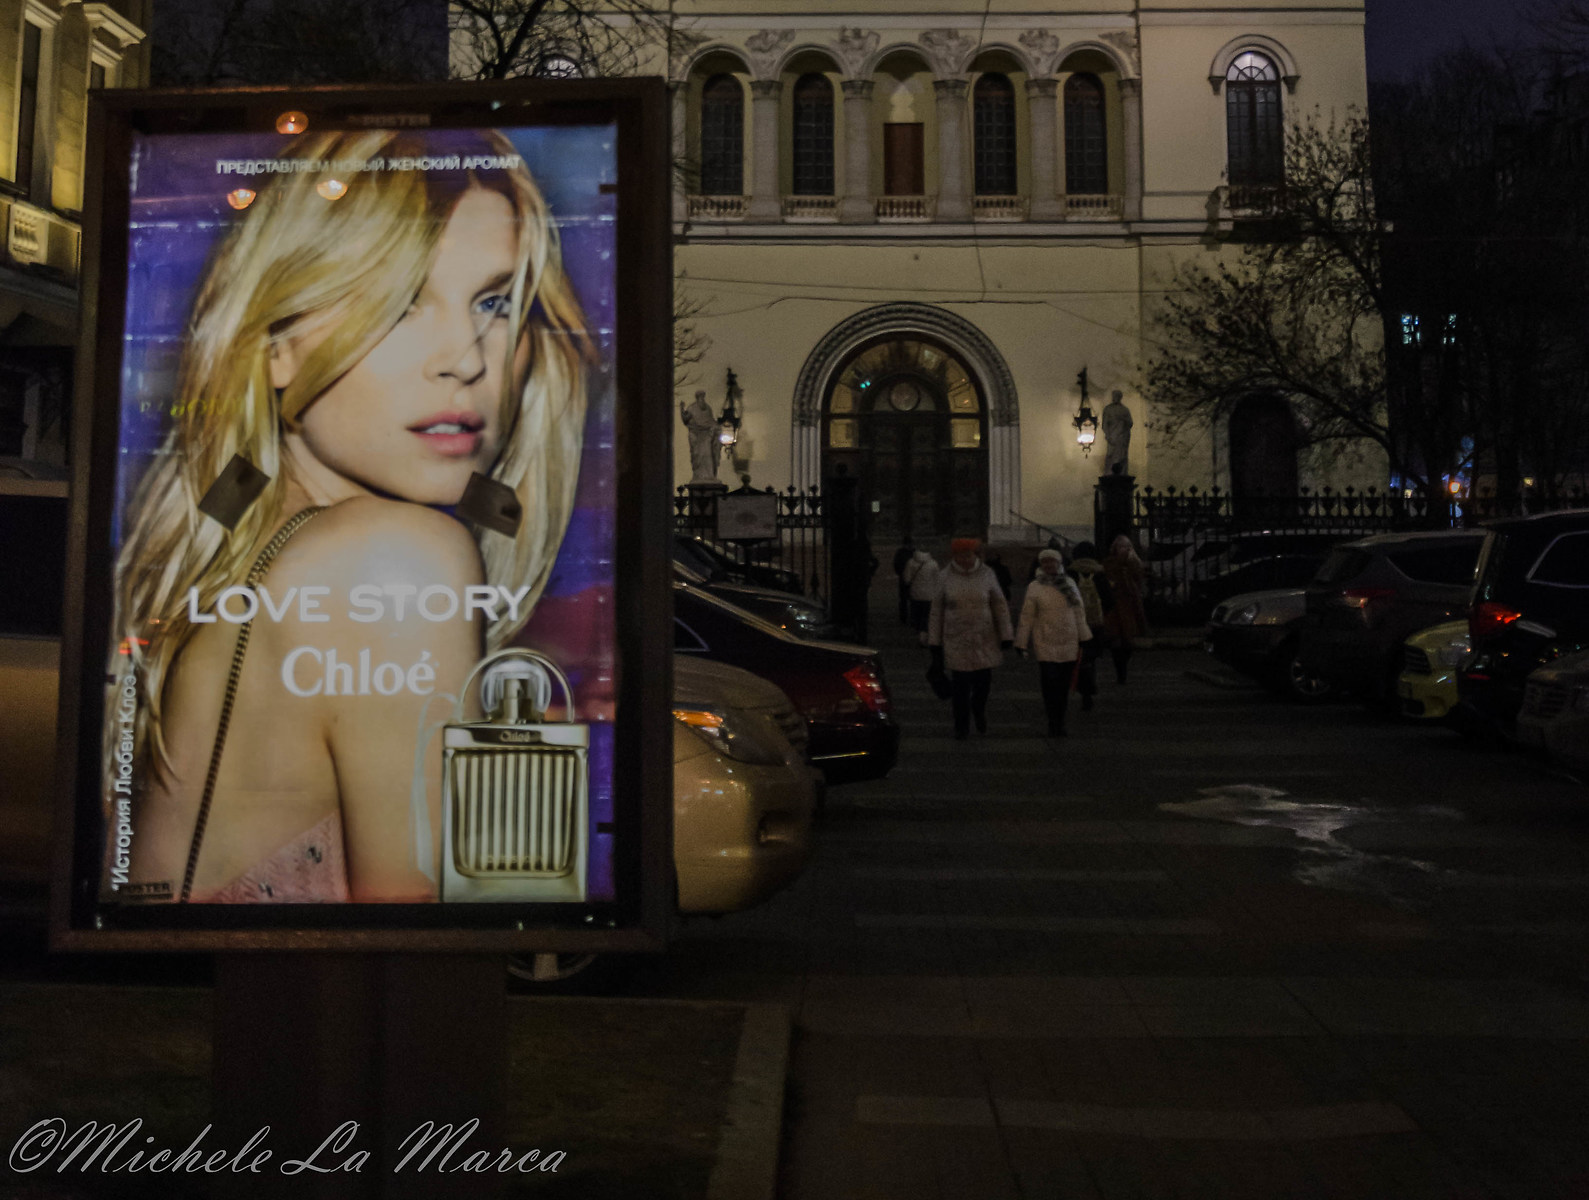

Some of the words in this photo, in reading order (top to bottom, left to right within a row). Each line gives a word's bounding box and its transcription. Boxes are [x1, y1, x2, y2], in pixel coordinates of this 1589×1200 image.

[216, 159, 330, 176] ПРЕДСТАВЛЯЕМ
[333, 157, 385, 172] НОВЫЙ
[388, 154, 460, 171] ЖЕНСКИЙ
[463, 154, 521, 170] АРОМАТ
[188, 585, 331, 624] LOVE
[348, 583, 532, 623] STORY
[281, 645, 437, 698] Chloé
[119, 674, 138, 723] Клоэ
[114, 729, 134, 796] Любви
